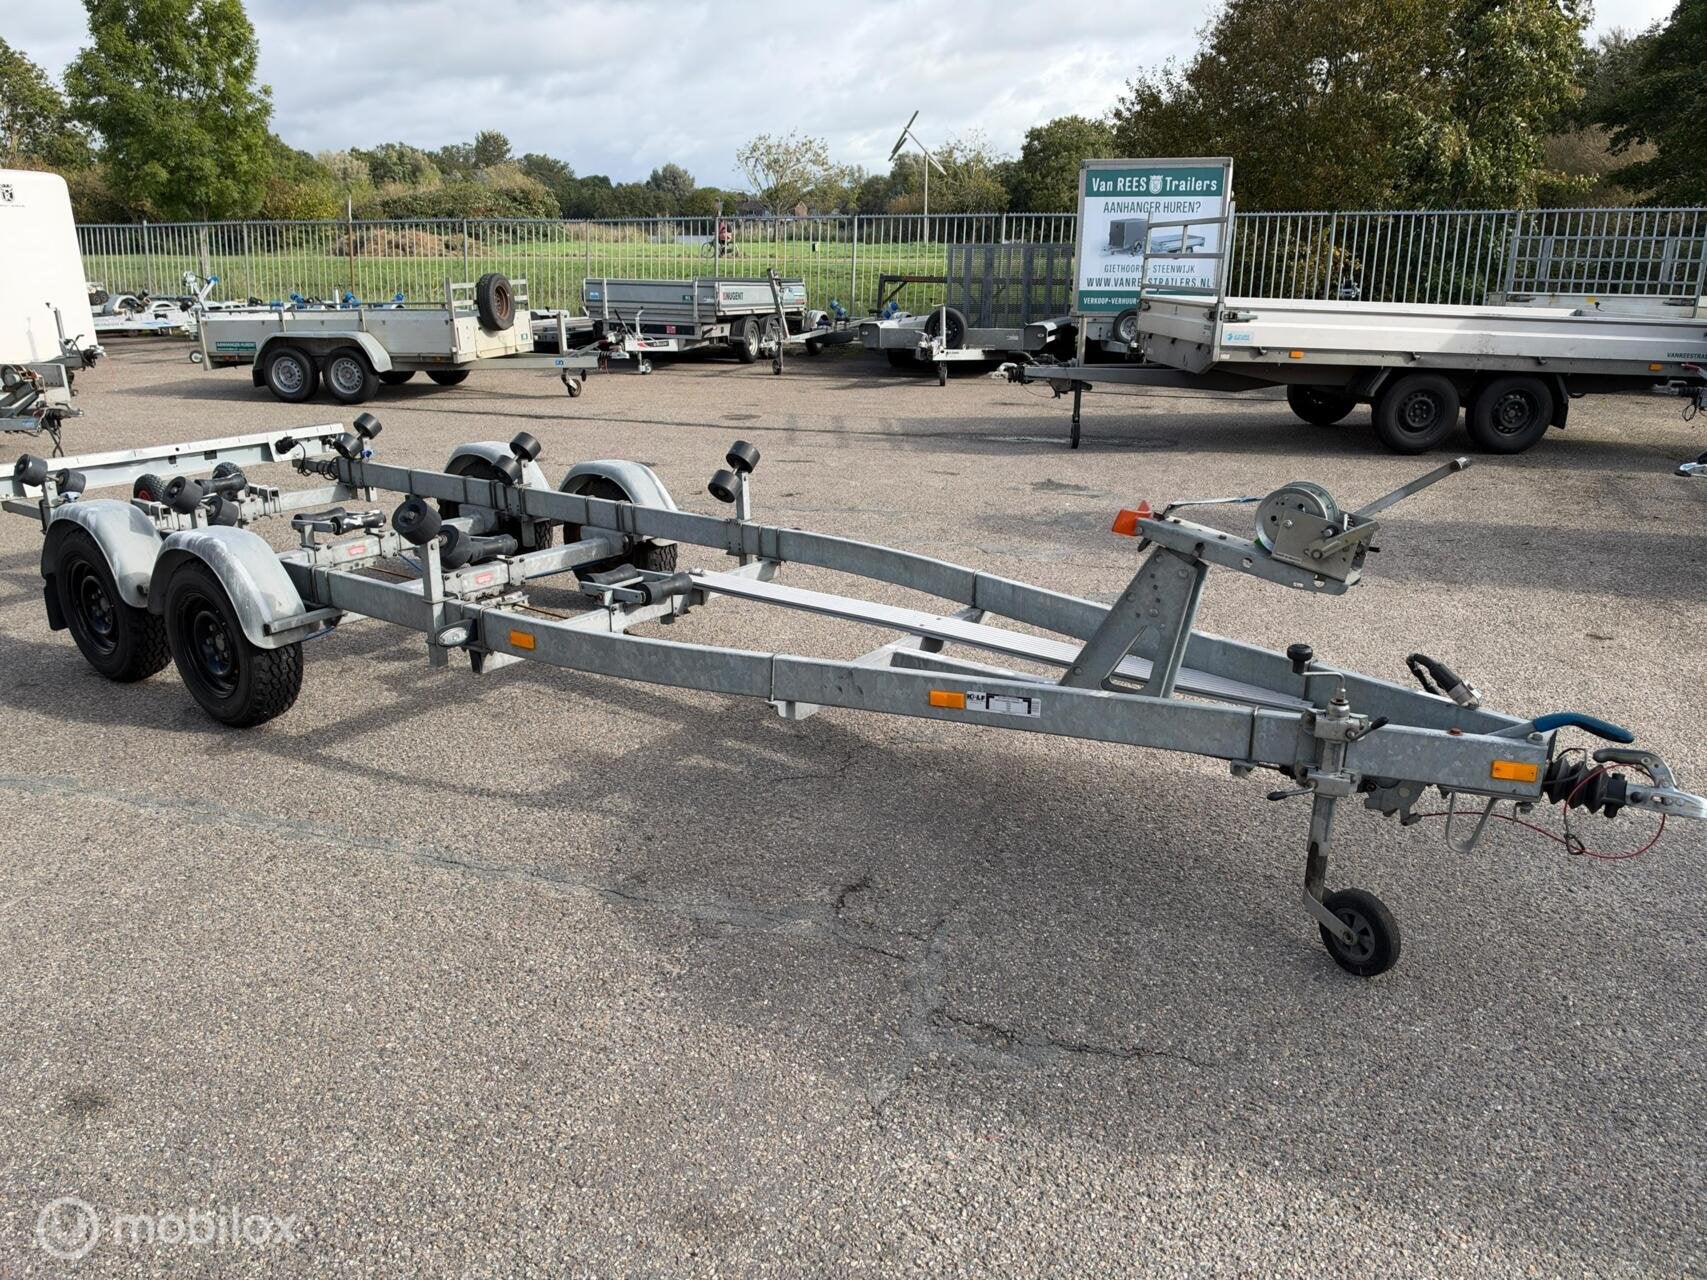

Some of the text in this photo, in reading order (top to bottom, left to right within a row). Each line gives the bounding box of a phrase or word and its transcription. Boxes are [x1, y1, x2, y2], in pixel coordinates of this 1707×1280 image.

[1092, 176, 1218, 192] Van REES Trailers
[1103, 201, 1202, 214] AANHANGER HUREN?
[1152, 264, 1196, 273] STEENWIJK
[1087, 277, 1212, 288] WWW.VANRESTRAILERS.NL
